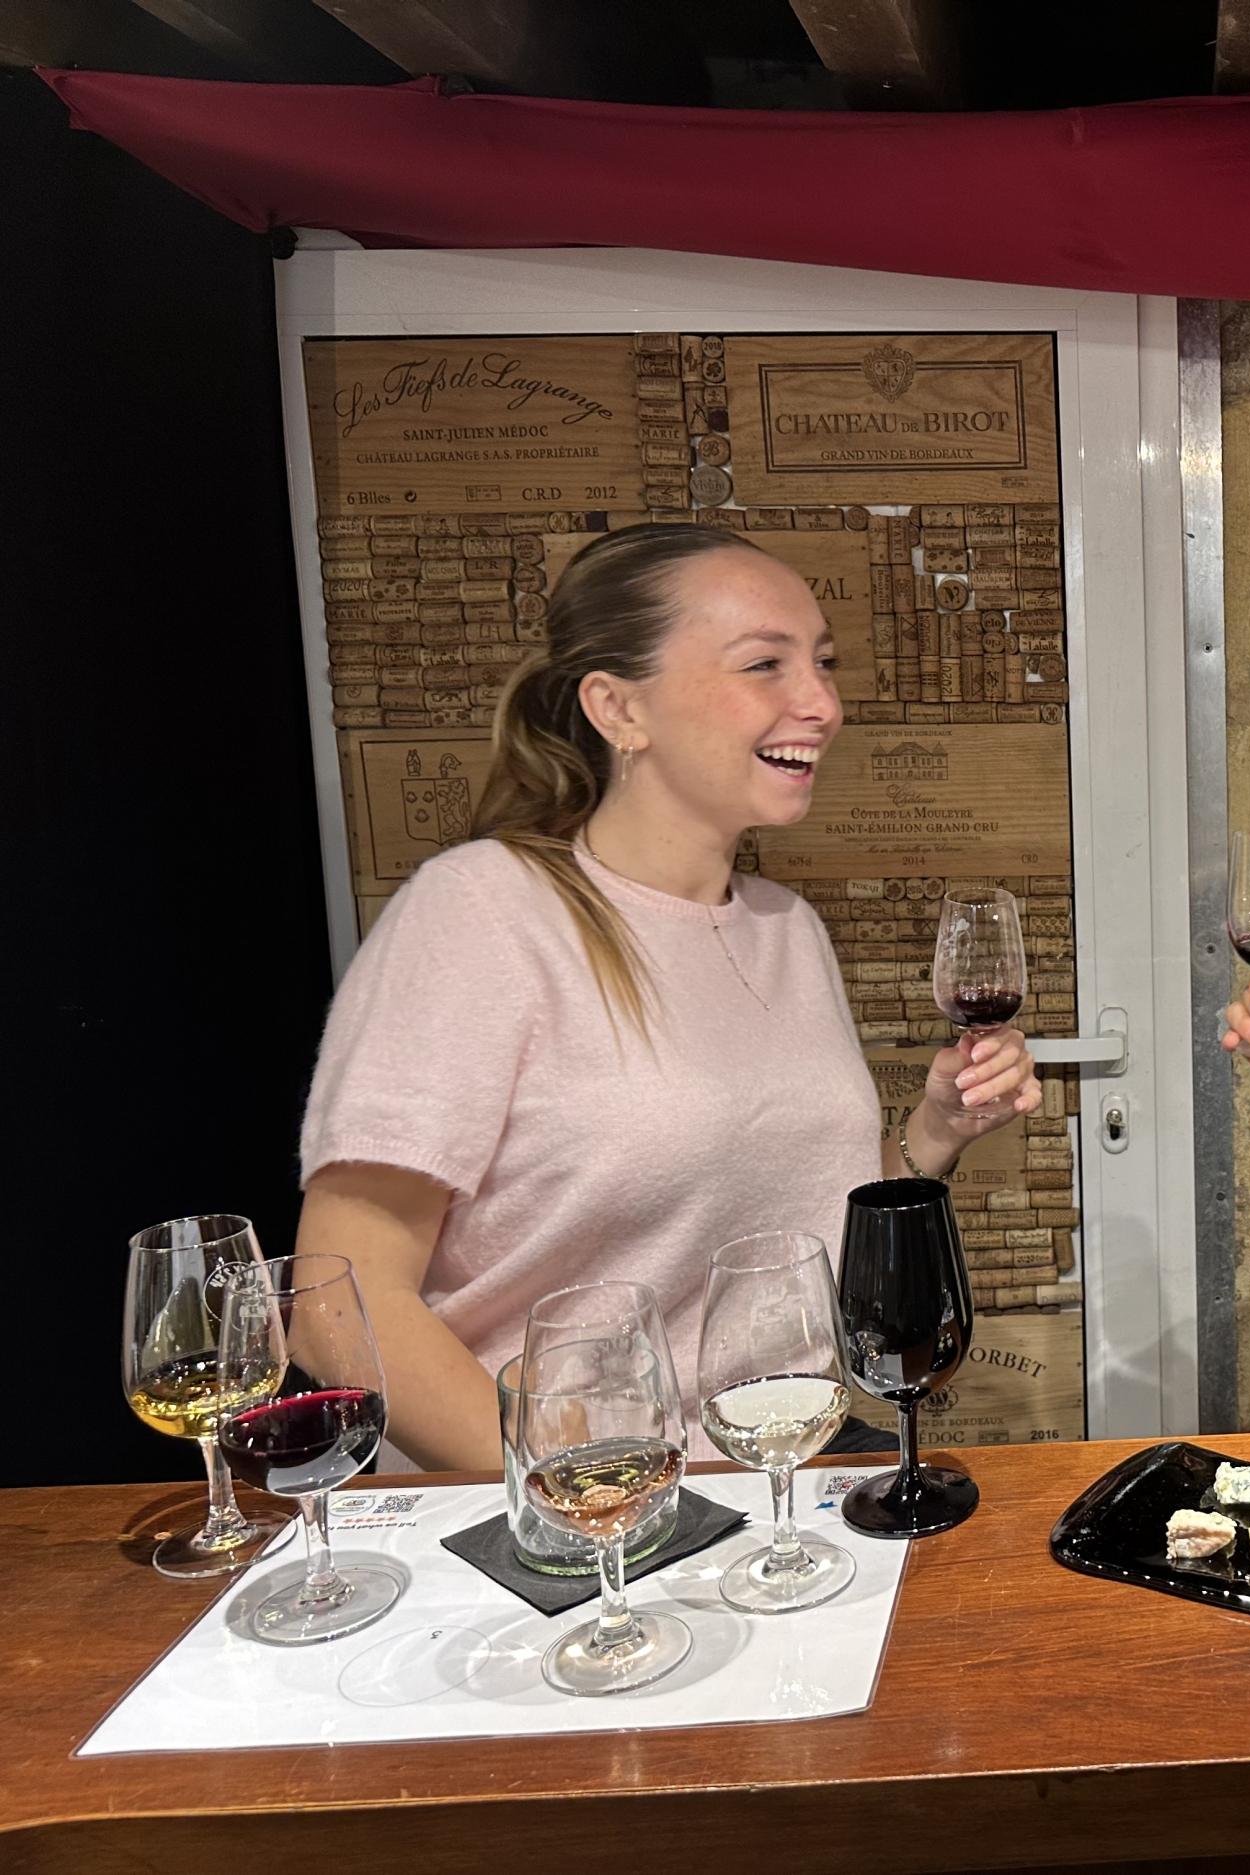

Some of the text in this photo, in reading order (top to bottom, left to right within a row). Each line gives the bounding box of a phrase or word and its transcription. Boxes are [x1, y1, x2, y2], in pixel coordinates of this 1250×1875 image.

[333, 353, 614, 438] Les Fiefs de Lagrange
[901, 422, 919, 433] DE
[924, 410, 1010, 433] BIROT
[402, 423, 550, 442] SAINT-JULIEN MÉDOC
[415, 449, 481, 463] LAGRANGE
[515, 445, 600, 460] PROPRIÉTAIRE
[820, 448, 975, 462] GRAND VIN DE BORDEAUX
[347, 492, 355, 505] 6
[585, 486, 617, 501] 2012
[825, 821, 1000, 834] SAINT-ÉMILION GRAND CRU
[902, 855, 926, 866] 2014
[870, 1420, 899, 1430] GRAN
[948, 1416, 1005, 1427] BORDEAUX
[918, 1429, 966, 1445] ÉDOC
[1030, 1429, 1060, 1441] 2016
